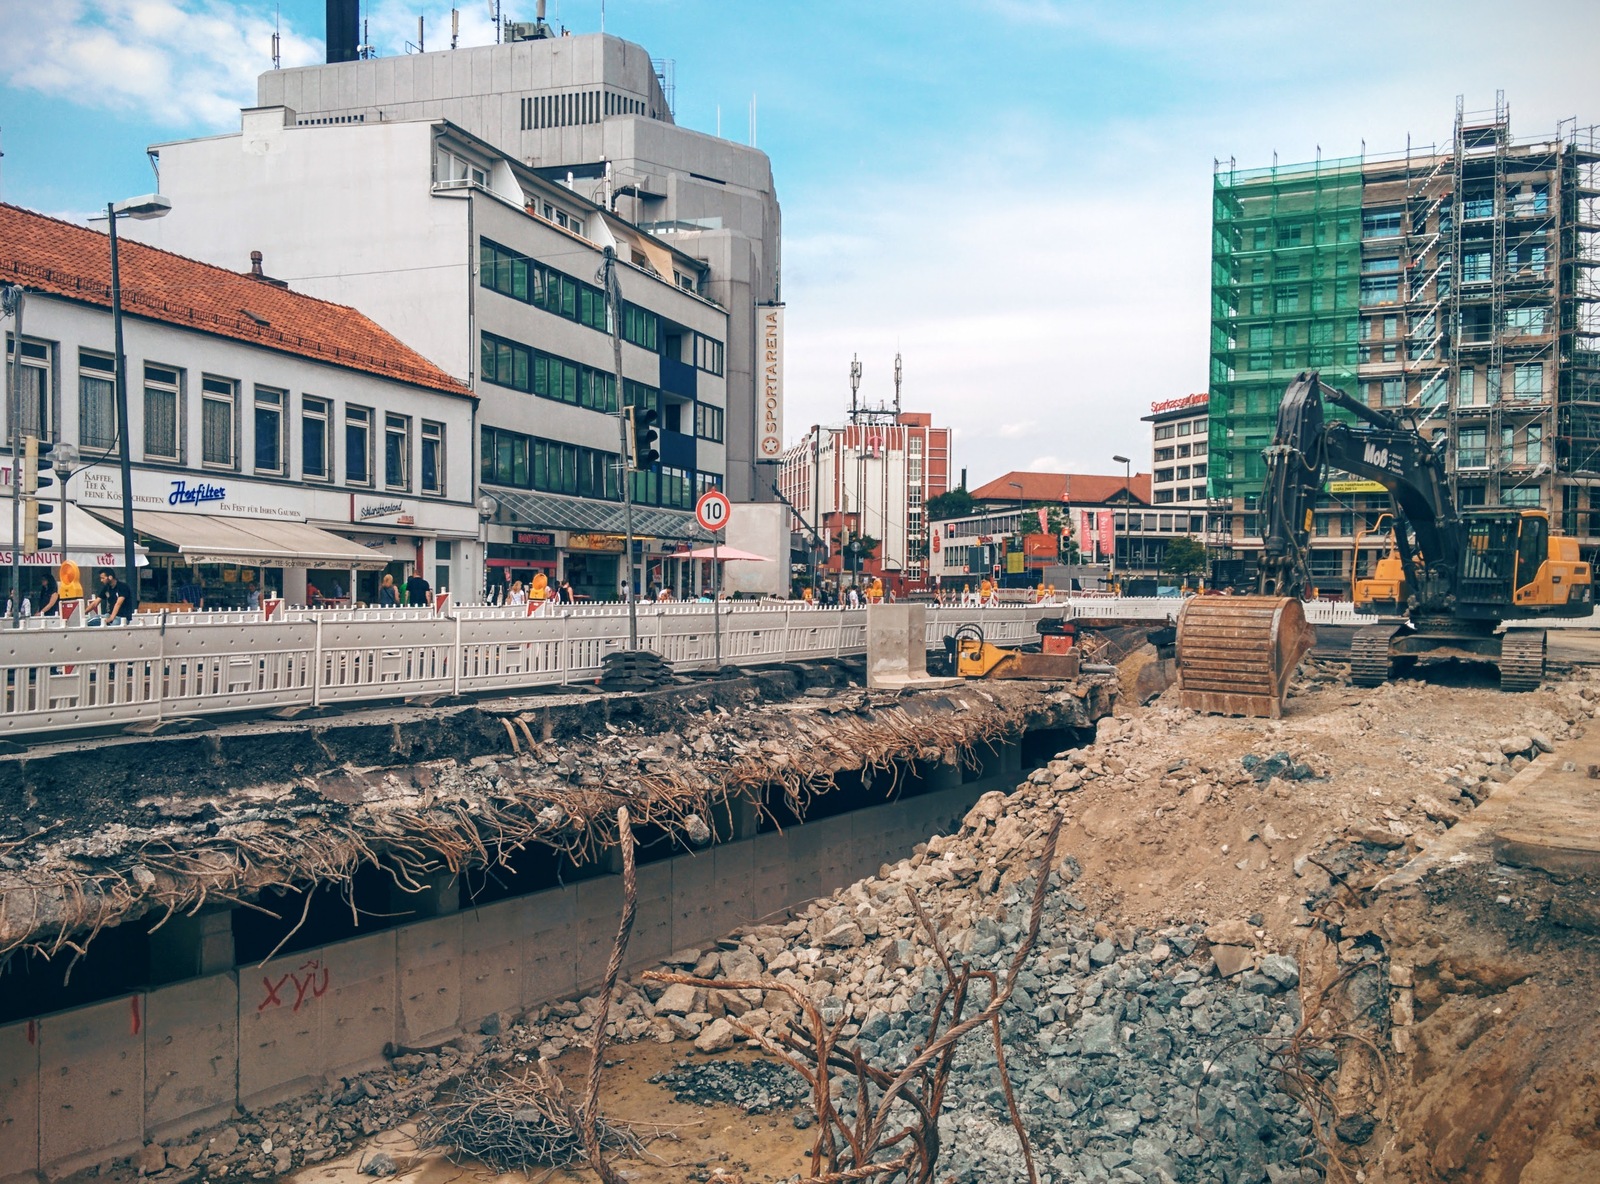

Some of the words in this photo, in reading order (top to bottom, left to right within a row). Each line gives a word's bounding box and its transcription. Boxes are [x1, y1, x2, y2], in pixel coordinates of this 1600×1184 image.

[765, 312, 777, 433] SPORTARENA
[107, 491, 164, 504] KÖSCHKEITEN
[169, 481, 226, 507] Hotfilter
[705, 502, 722, 519] 10
